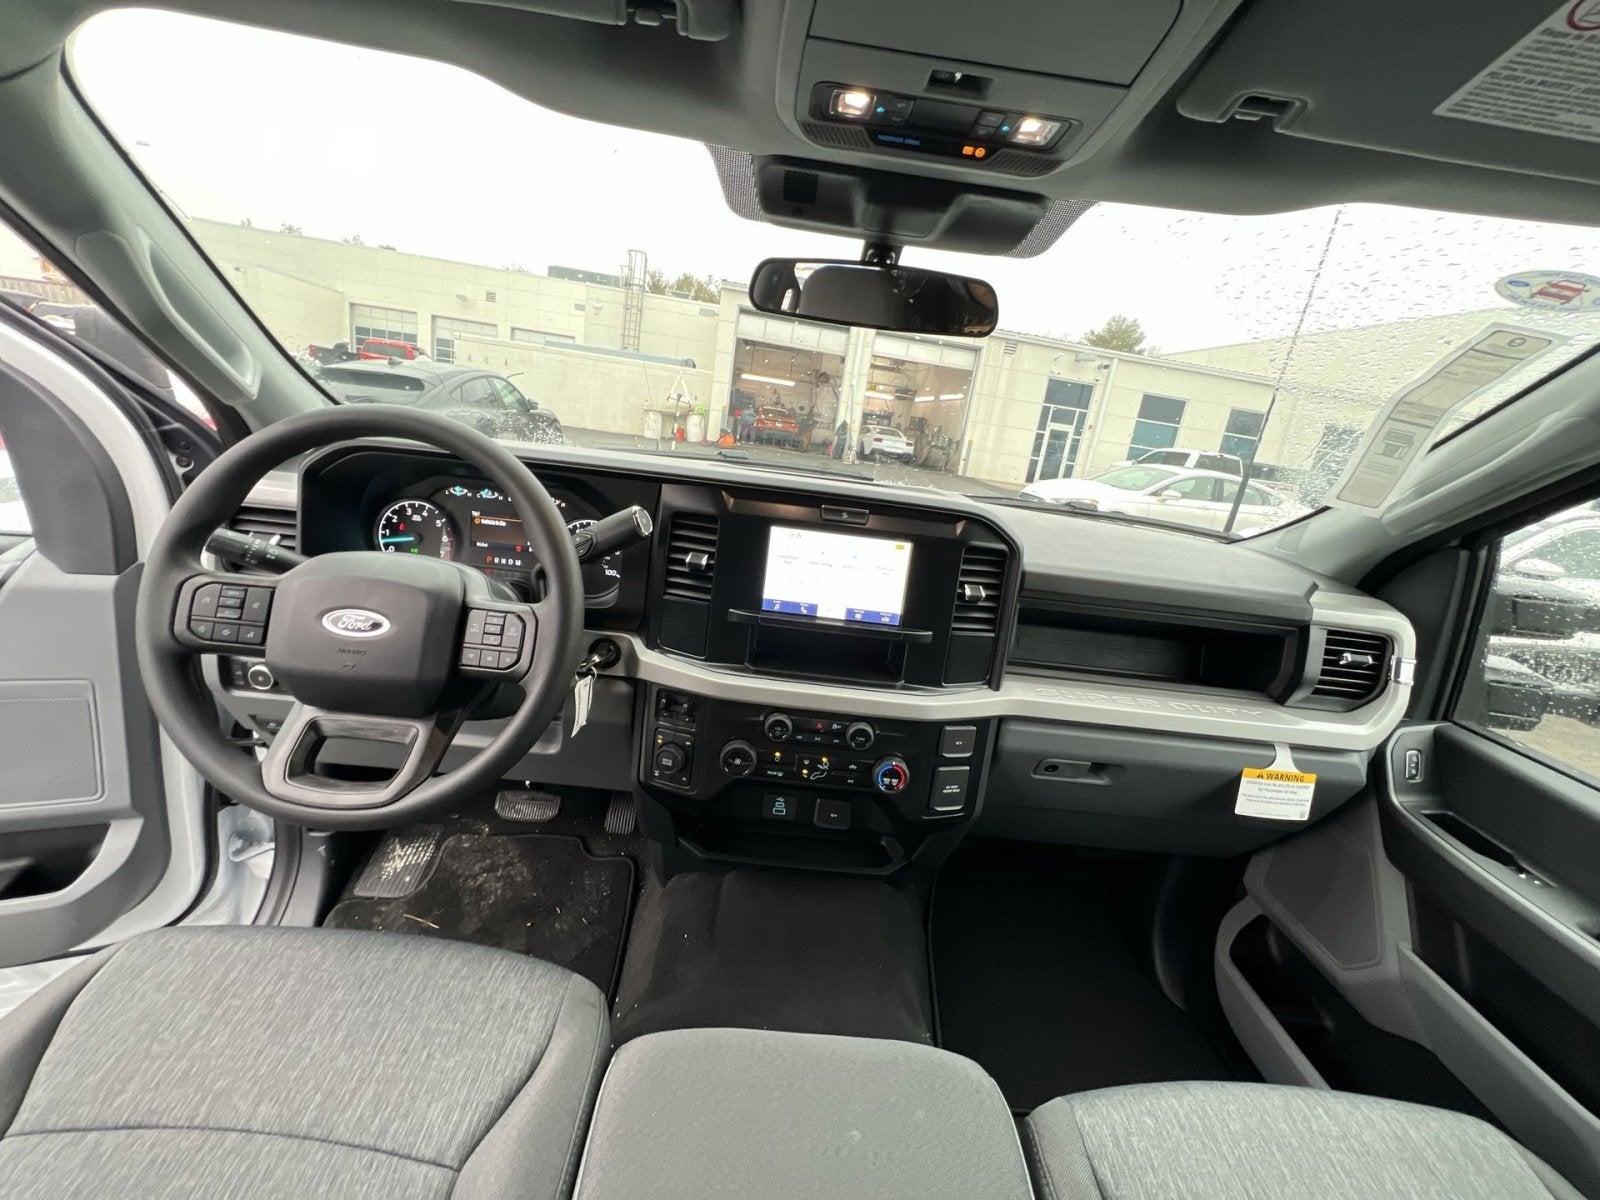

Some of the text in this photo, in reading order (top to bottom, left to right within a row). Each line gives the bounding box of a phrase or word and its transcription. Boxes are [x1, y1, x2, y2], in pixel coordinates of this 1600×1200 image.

[392, 515, 398, 523] 2
[1035, 687, 1263, 719] SUPER DUTY
[1266, 772, 1305, 783] WARNING
